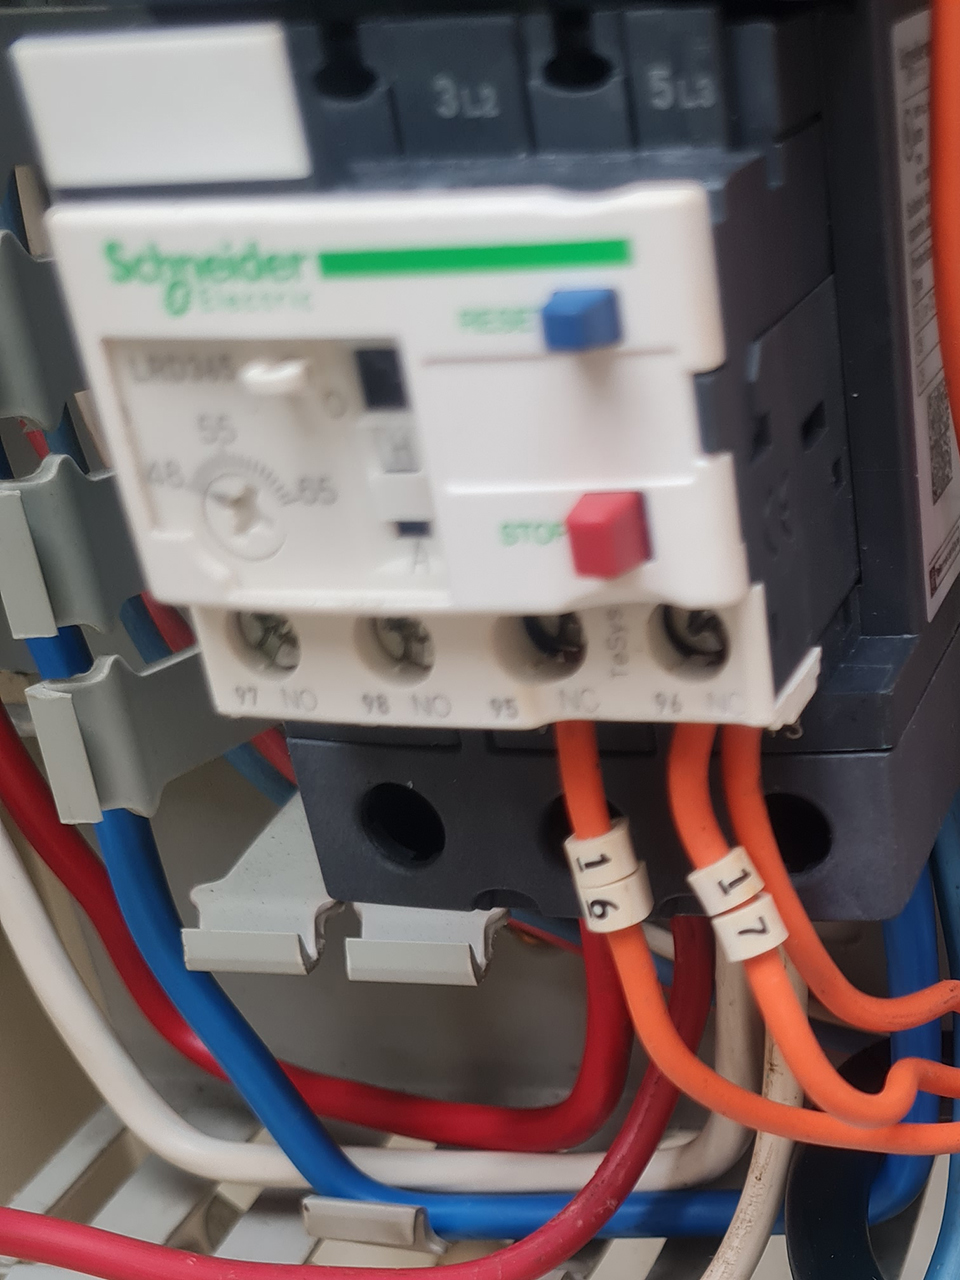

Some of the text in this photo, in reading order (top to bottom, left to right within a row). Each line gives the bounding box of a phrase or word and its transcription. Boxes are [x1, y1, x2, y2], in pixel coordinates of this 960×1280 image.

[104, 239, 303, 290] Schneider
[196, 413, 238, 446] 55
[235, 686, 258, 707] 97
[361, 693, 390, 716] 98
[653, 692, 682, 714] 96
[489, 697, 519, 720] 95
